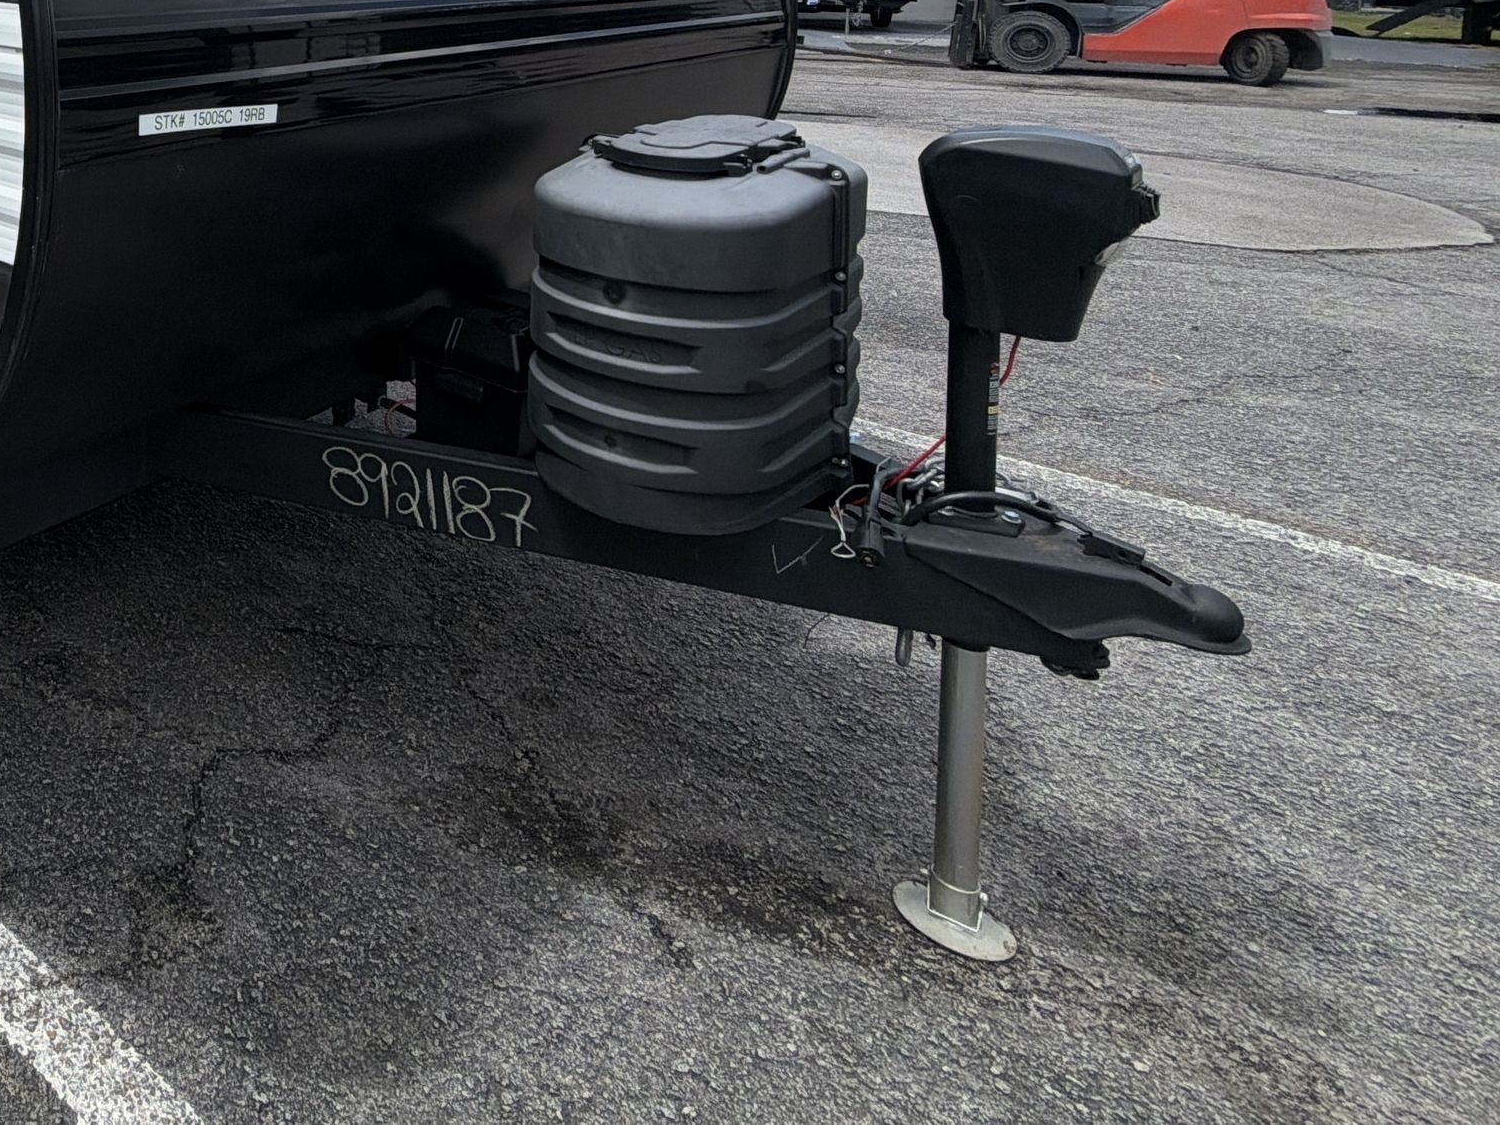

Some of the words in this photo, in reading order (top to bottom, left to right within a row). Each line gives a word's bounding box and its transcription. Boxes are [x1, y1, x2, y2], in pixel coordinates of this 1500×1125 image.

[154, 113, 185, 131] STK#
[193, 109, 233, 126] 15005C
[239, 107, 266, 123] 19RB
[322, 446, 539, 548] 8921187
